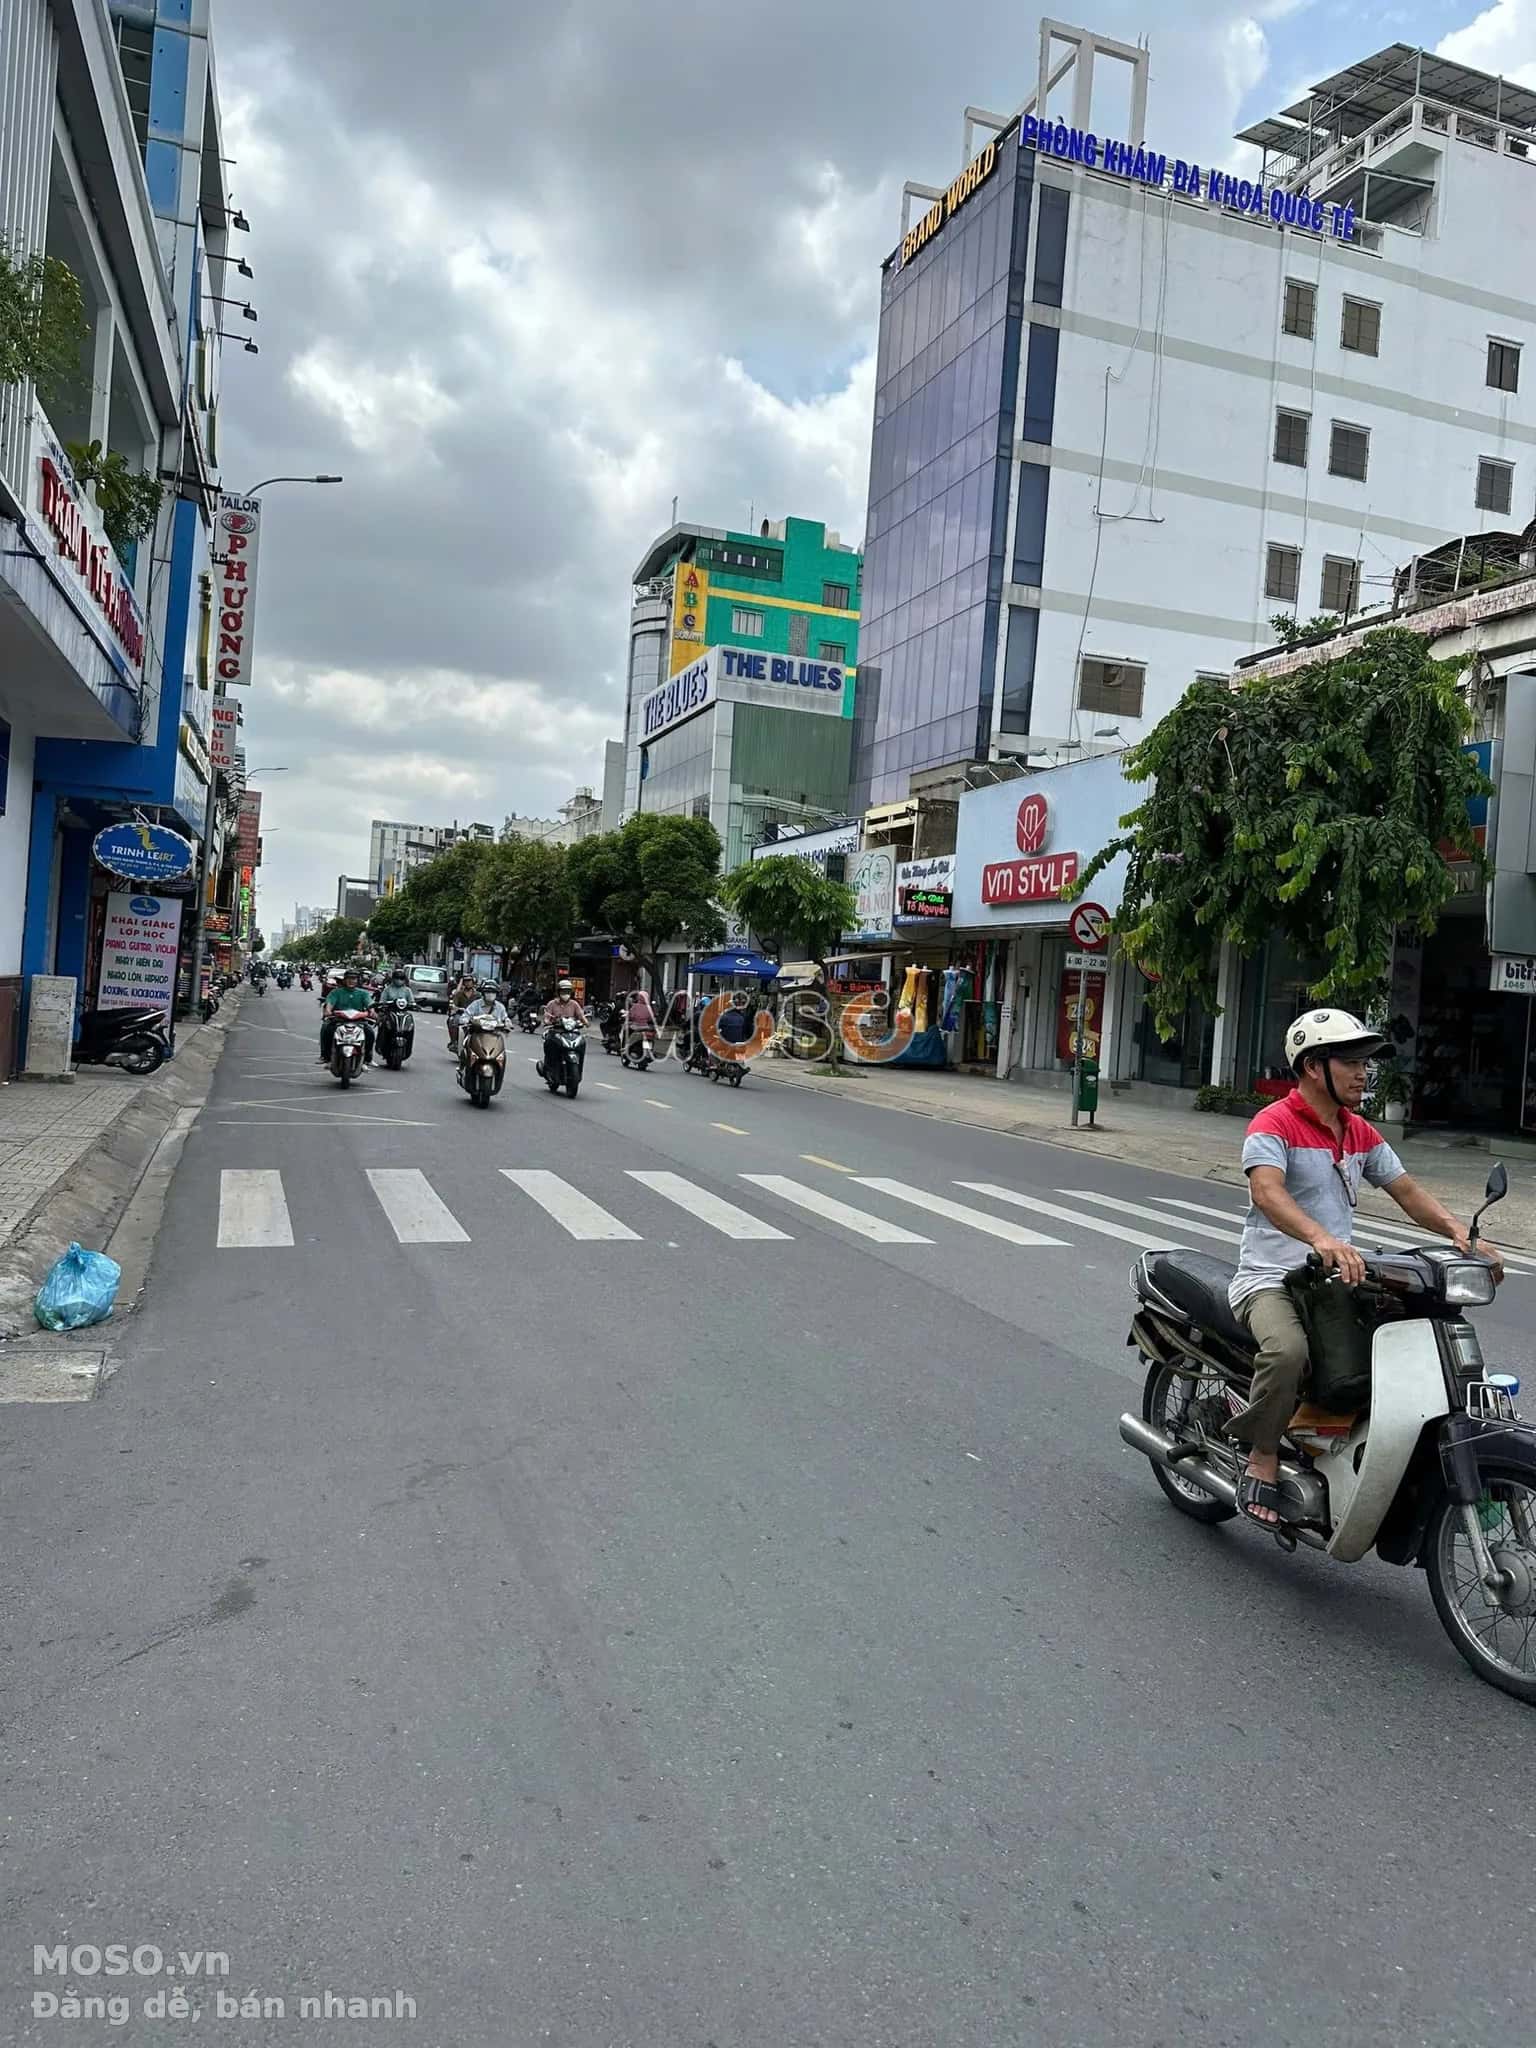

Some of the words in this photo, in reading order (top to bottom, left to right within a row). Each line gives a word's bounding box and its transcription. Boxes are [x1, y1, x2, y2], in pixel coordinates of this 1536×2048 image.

[901, 199, 943, 267] GRAND
[946, 142, 996, 217] WORLD
[1023, 114, 1096, 164] PHÒNG
[1103, 139, 1166, 185] KHÁM
[1174, 159, 1200, 197] ĐA
[1208, 168, 1263, 214] KHOA
[1268, 185, 1323, 230] QUỐC
[1331, 198, 1355, 241] TẾ
[219, 495, 260, 514] TAILOR
[217, 533, 249, 680] PHƯƠNG
[644, 690, 665, 736] THE
[666, 658, 709, 722] BLUES
[722, 650, 766, 680] THE
[770, 657, 842, 692] BLUES
[986, 868, 1014, 898] VM
[1017, 859, 1075, 895] STYLE
